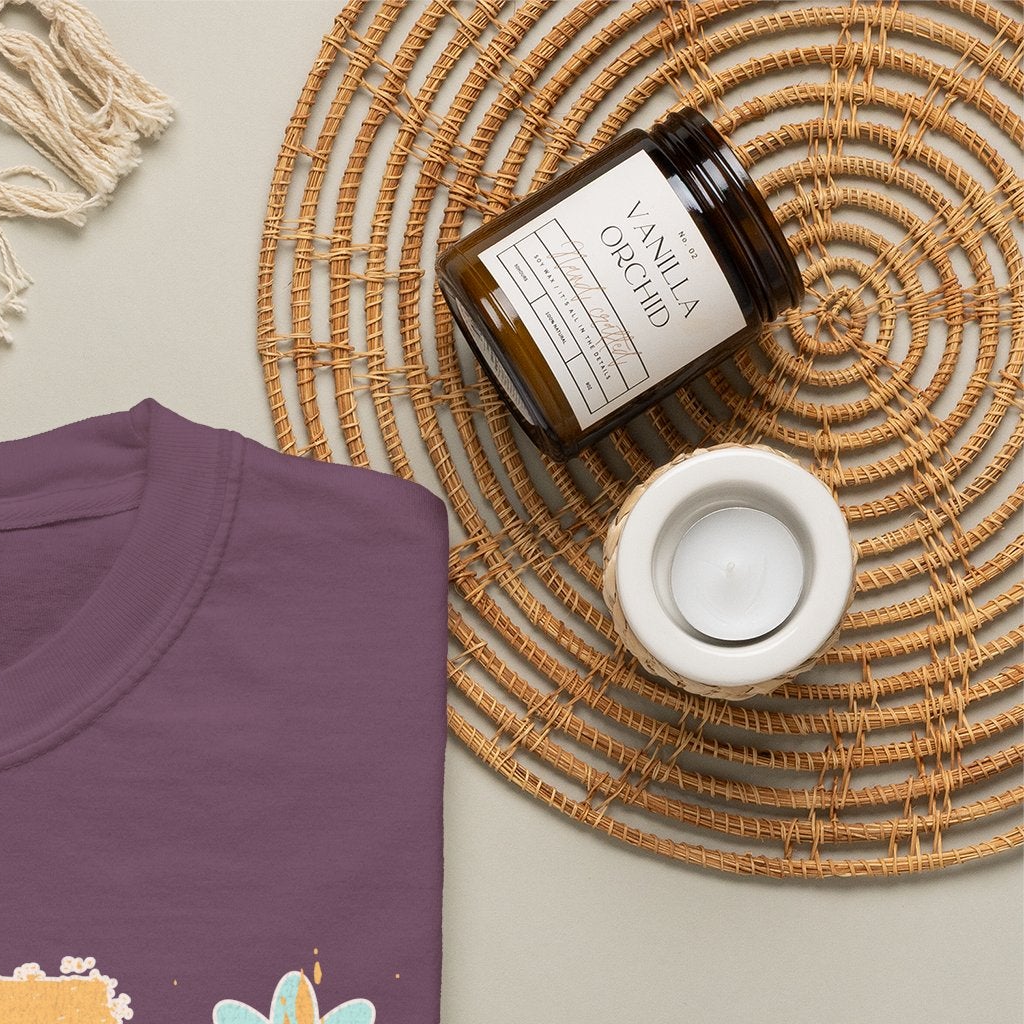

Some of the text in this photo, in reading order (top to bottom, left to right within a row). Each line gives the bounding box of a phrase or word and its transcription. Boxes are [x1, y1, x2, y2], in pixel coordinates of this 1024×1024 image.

[600, 225, 670, 328] ORCHID
[627, 200, 700, 319] VANILLA
[678, 231, 698, 260] No. 02
[533, 254, 544, 267] SOY
[544, 269, 555, 283] WAX
[569, 308, 578, 323] ALL
[578, 324, 585, 334] IN
[585, 335, 595, 349] THE
[593, 351, 611, 380] DETAILS
[553, 323, 567, 344] NATURAL
